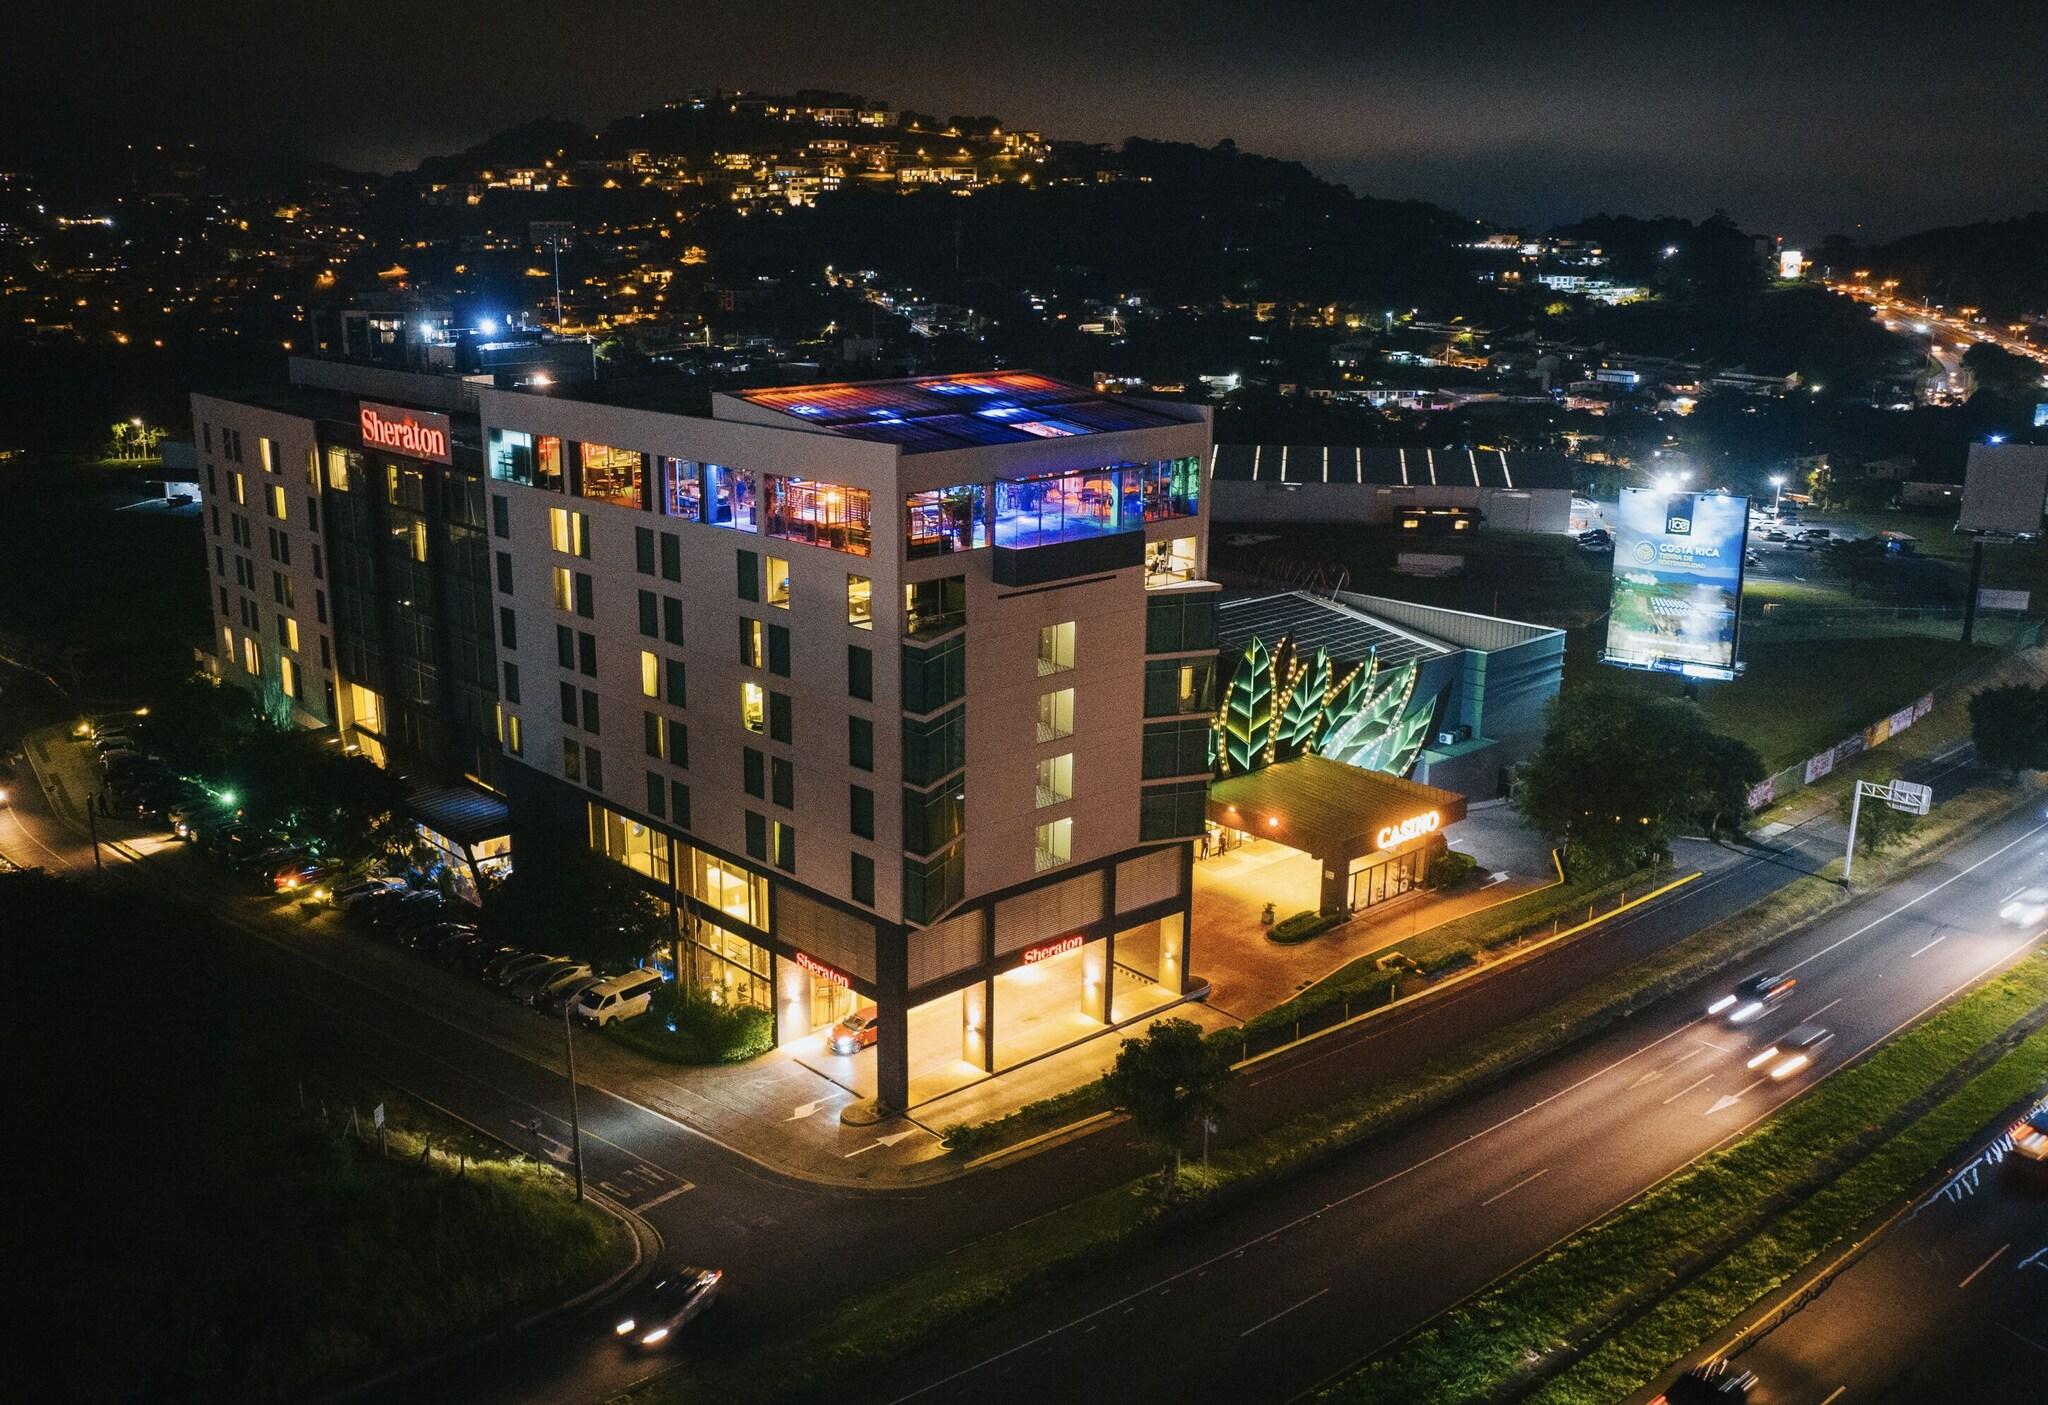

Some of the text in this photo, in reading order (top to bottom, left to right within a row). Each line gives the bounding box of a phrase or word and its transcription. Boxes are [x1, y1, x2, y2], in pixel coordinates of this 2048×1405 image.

[361, 409, 446, 456] Sheraton
[1659, 543, 1720, 558] COSTA RICA
[1377, 811, 1440, 849] CASINO
[1024, 936, 1083, 965] Sheraton
[796, 952, 849, 987] Sheraton
